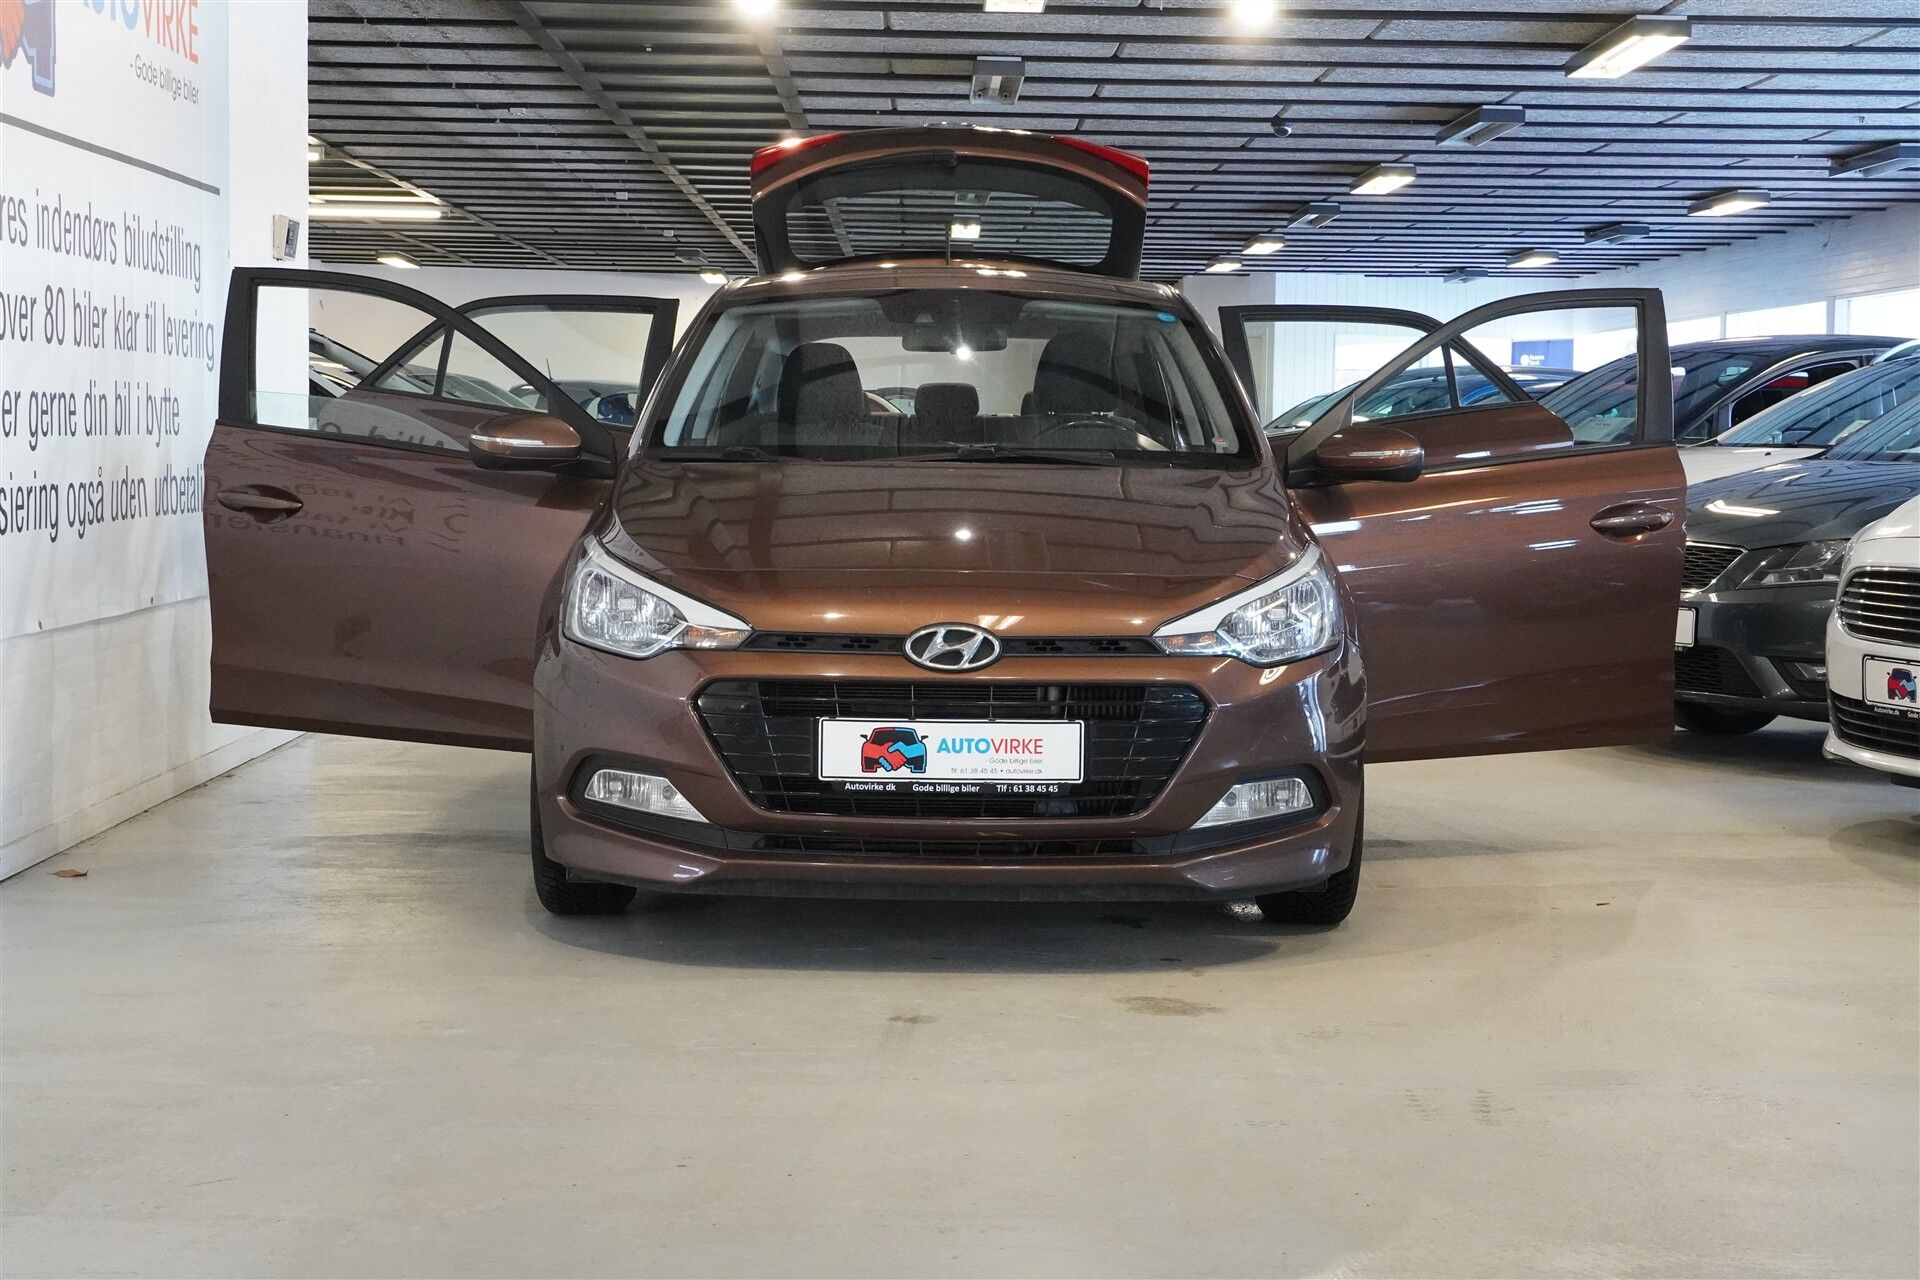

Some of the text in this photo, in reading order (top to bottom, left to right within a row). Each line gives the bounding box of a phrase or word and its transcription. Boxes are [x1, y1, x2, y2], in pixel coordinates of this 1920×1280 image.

[135, 54, 157, 86] Gode
[36, 188, 117, 266] indendørs
[124, 211, 201, 294] biludstilling
[44, 284, 66, 346] 80
[73, 288, 107, 350] biler
[114, 295, 140, 352] klar
[145, 301, 157, 354] til
[163, 303, 215, 372] levering
[2, 390, 21, 438] er
[29, 390, 77, 451] gerne
[84, 379, 107, 437] din
[114, 380, 130, 436] bil
[146, 382, 180, 447] bytte
[67, 466, 104, 539] også
[110, 465, 148, 521] uden
[937, 738, 1043, 754] AUTOVIRKE
[844, 782, 884, 791] Autovirke
[912, 783, 934, 792] Gode
[936, 784, 960, 794] billige
[962, 784, 980, 793] biler
[1013, 785, 1023, 793] 61
[1025, 785, 1035, 793] 38
[1036, 785, 1047, 793] 45
[1048, 785, 1059, 793] 45
